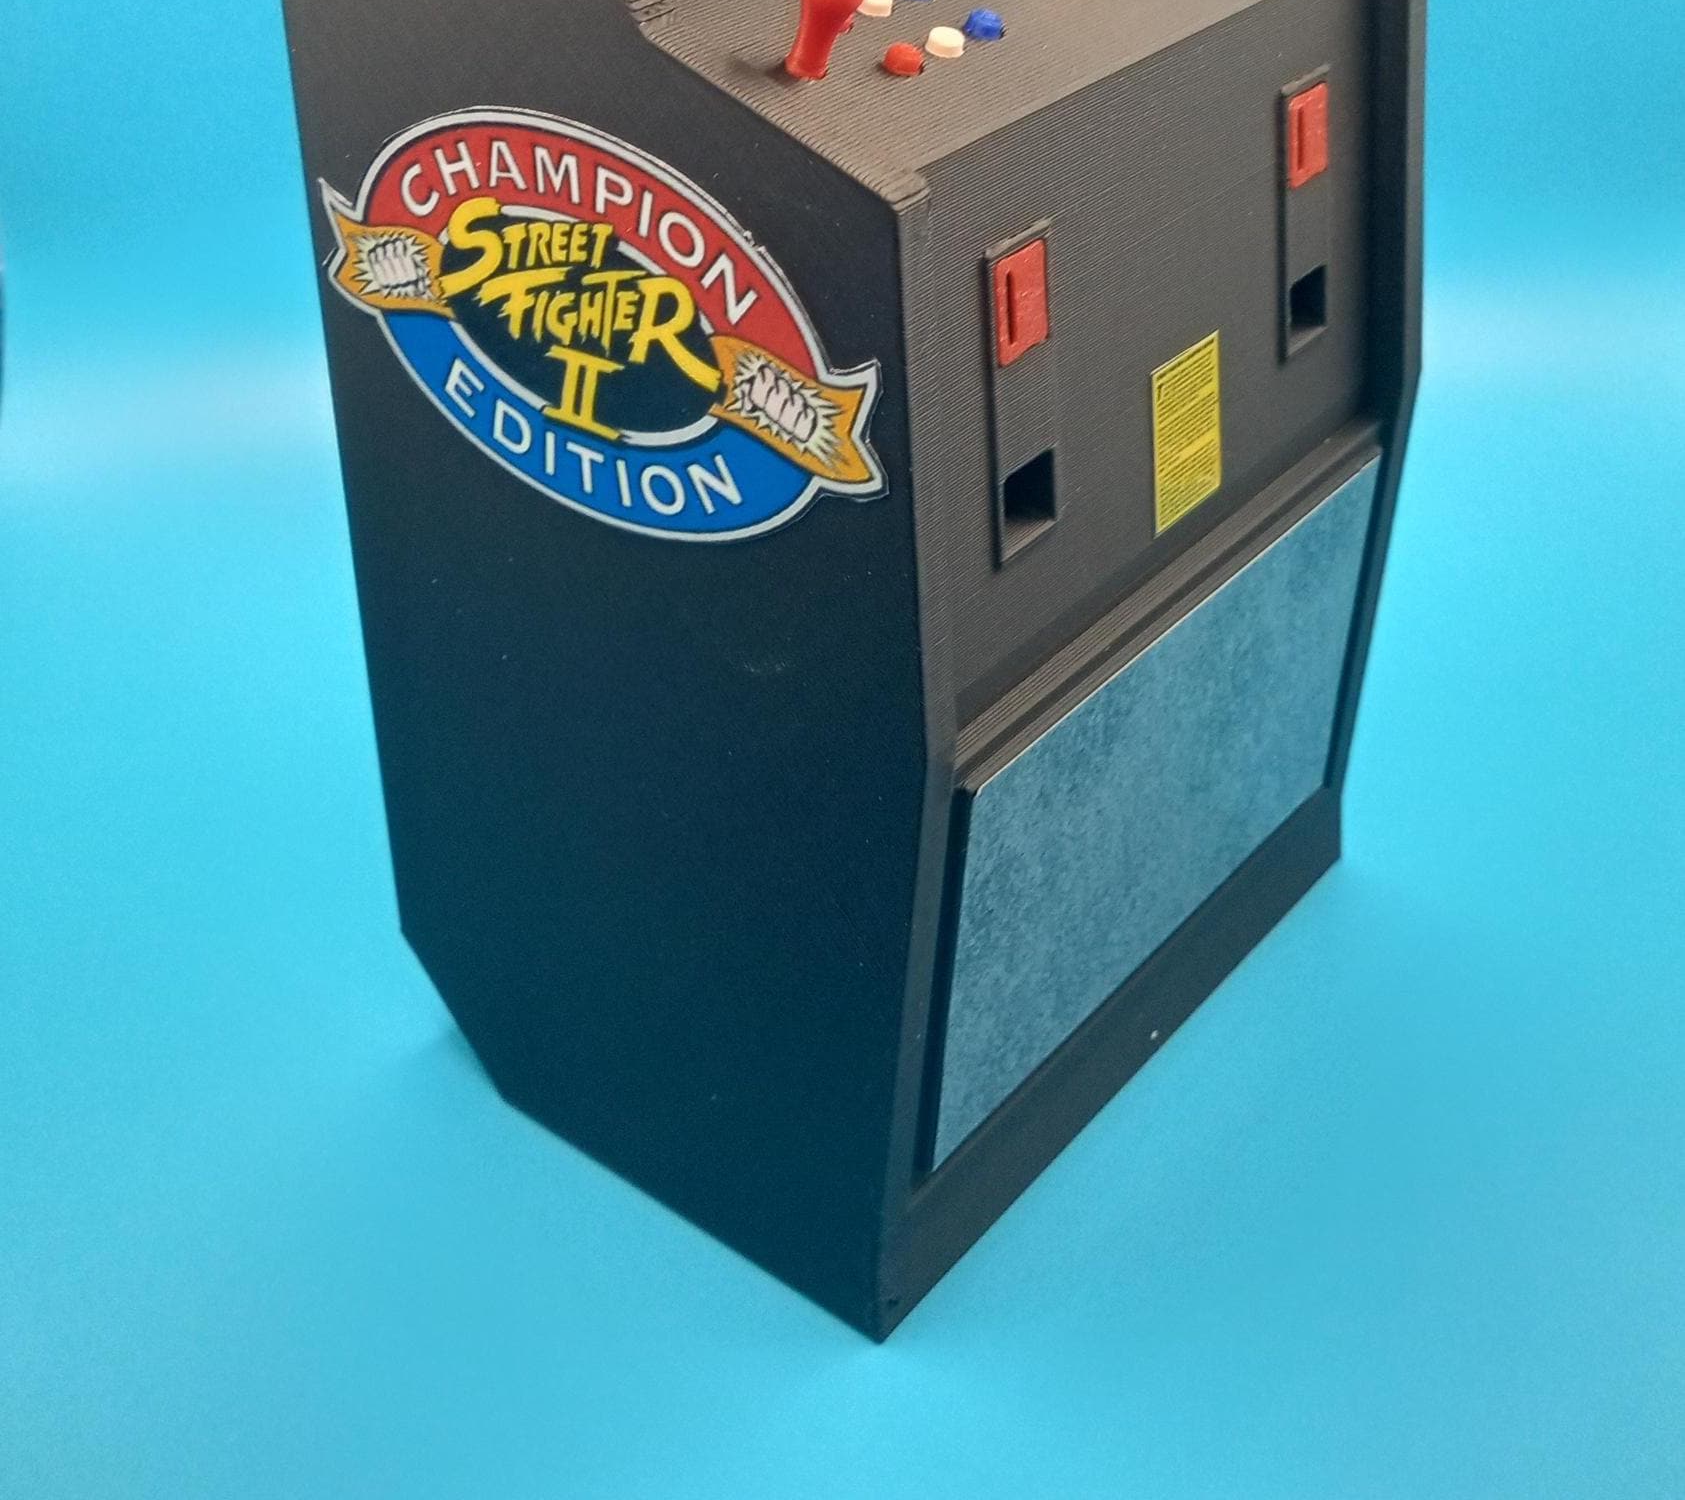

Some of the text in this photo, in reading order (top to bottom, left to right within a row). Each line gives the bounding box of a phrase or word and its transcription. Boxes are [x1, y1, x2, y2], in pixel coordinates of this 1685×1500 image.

[400, 140, 758, 327] CHAMPION
[437, 197, 613, 300] STREET
[478, 266, 724, 392] FIGHTER
[444, 357, 744, 515] EDITION
[542, 345, 625, 442] II
